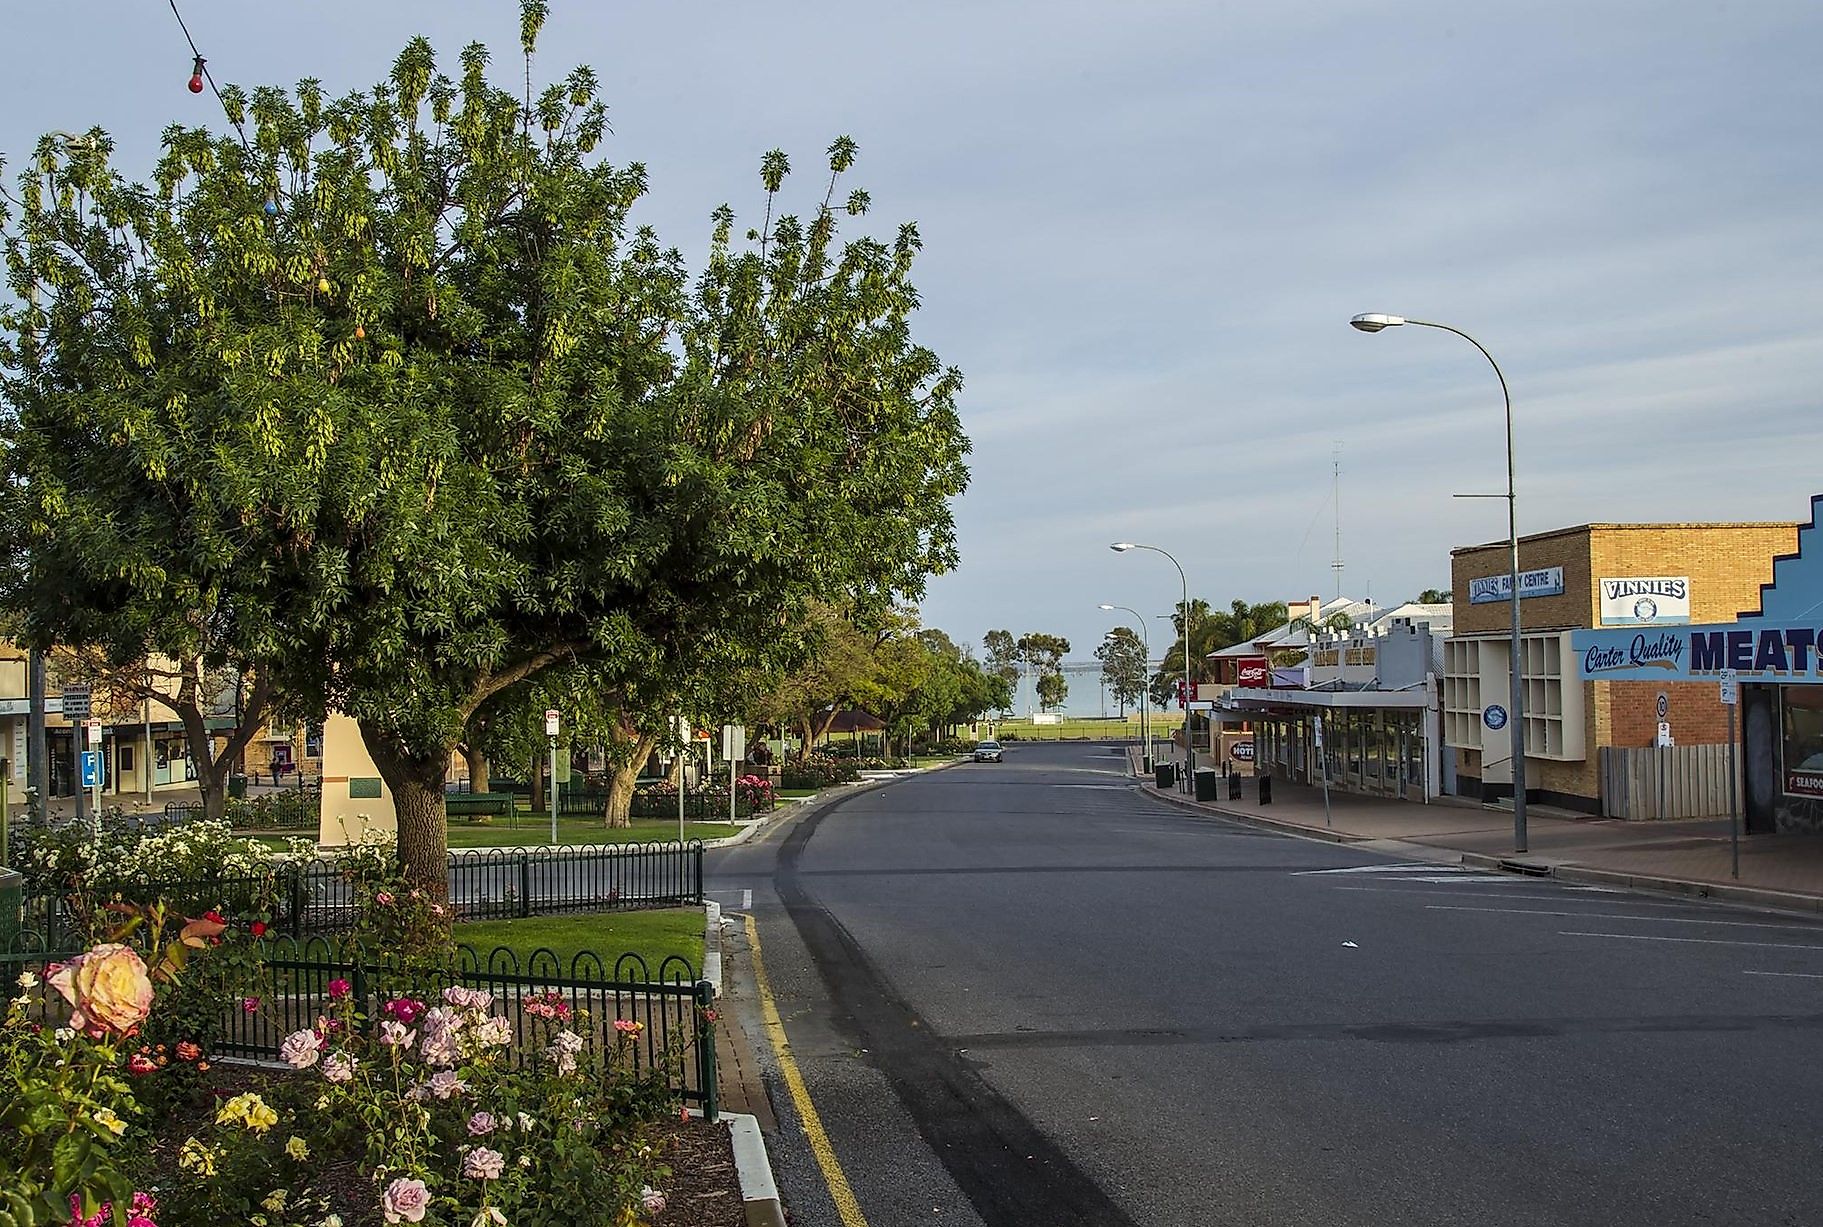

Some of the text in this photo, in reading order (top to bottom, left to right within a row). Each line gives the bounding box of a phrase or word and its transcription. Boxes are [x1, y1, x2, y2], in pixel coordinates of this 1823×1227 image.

[1524, 571, 1549, 587] CENTRE
[1604, 580, 1685, 600] VINNIES
[1585, 628, 1823, 676] Carter Quality MEAT
